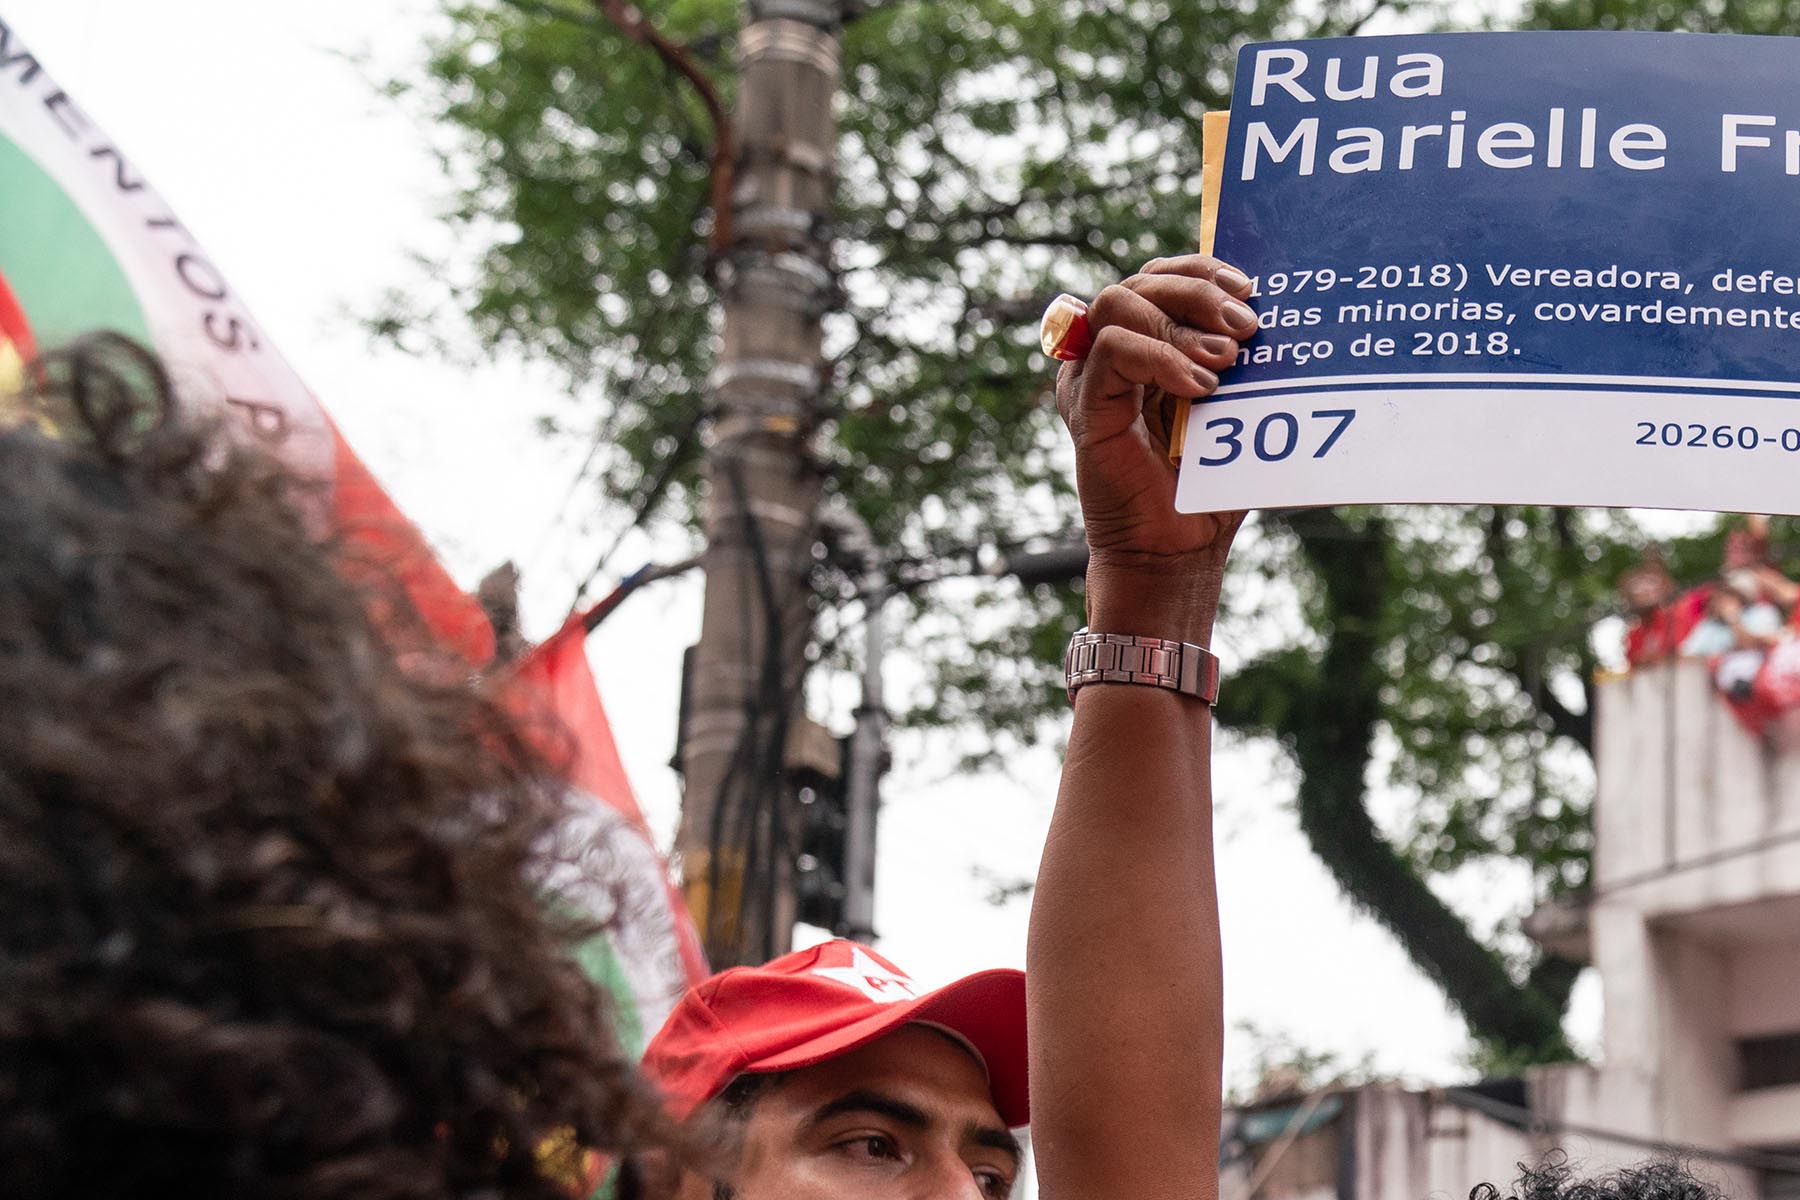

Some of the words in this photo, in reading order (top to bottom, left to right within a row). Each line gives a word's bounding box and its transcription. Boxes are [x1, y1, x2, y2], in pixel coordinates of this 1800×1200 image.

[1250, 48, 1445, 106] Rua
[1240, 107, 1668, 181] Marielle
[1248, 263, 1469, 298] 1979-2018)
[1485, 263, 1695, 295] Vereadora,
[1257, 305, 1323, 330] das
[1337, 297, 1517, 325] minorias,
[1349, 333, 1396, 357] de
[1411, 331, 1523, 356] 2018.
[1198, 407, 1357, 468] 307
